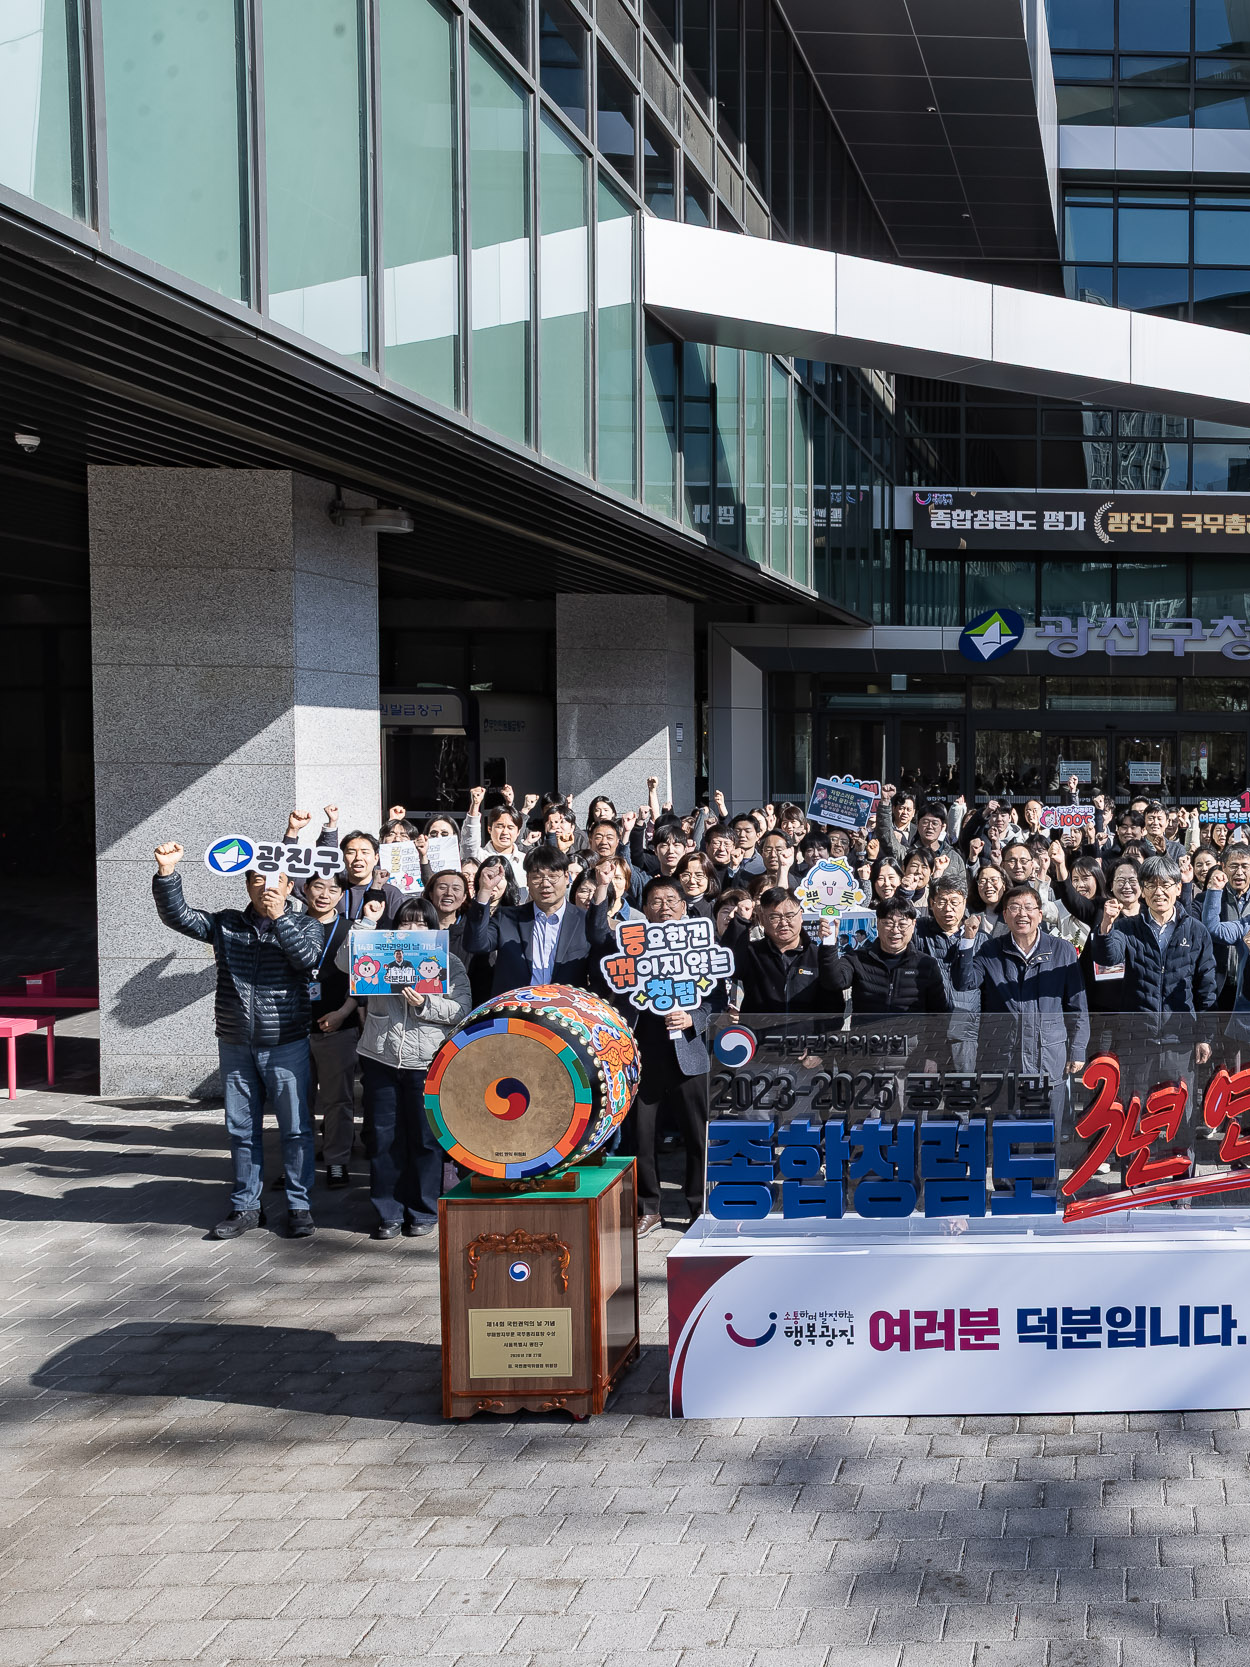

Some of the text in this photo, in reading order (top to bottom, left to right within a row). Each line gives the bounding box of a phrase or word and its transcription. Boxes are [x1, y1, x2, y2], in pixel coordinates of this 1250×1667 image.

[930, 509, 1037, 531] 종합청렴도
[1043, 509, 1086, 531] 평가
[1108, 512, 1175, 533] 광진구
[1199, 812, 1228, 823] 여러분
[256, 843, 343, 876] 광진구
[374, 943, 411, 951] 국민권익의
[412, 943, 420, 951] 날
[384, 975, 420, 983] 덕분입니다
[606, 948, 730, 988] 꺾이지 않는
[646, 977, 697, 1009] 청렴
[762, 1034, 909, 1058] 국민권익위원회
[710, 1071, 1054, 1111] 2023-2025 공공기관
[707, 1118, 1057, 1220] 종합청렴도
[1062, 1051, 1192, 1196] 3년
[783, 1309, 855, 1325] 소통하며 발전하는
[869, 1307, 1000, 1352] 여러분
[1017, 1303, 1247, 1351] 덕분입니다.
[784, 1323, 855, 1347] 행복광진
